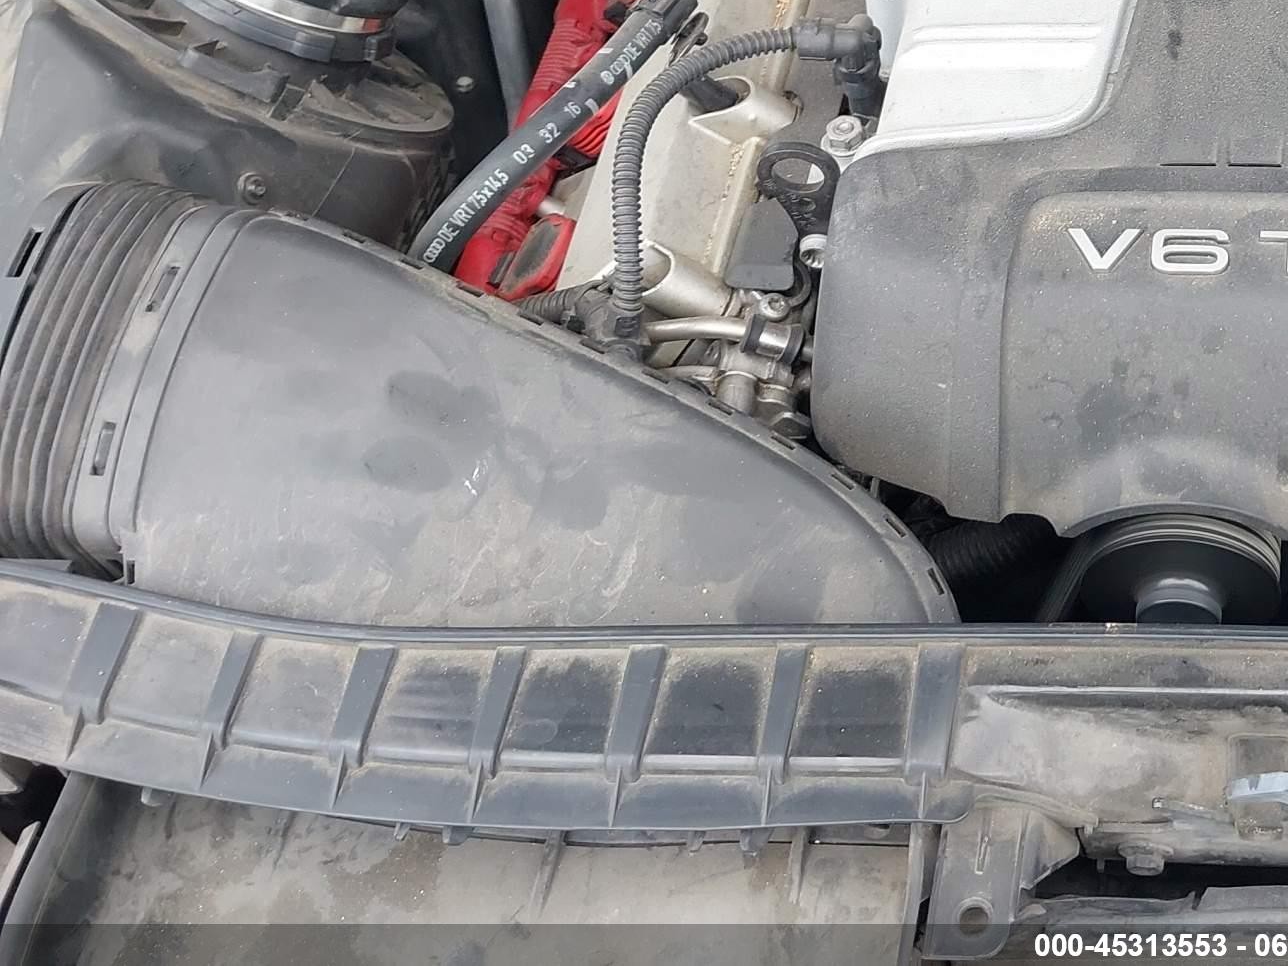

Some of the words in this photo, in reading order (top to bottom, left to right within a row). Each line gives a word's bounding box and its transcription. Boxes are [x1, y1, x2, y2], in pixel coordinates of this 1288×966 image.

[623, 42, 641, 60] DE
[633, 28, 652, 48] VRT
[439, 222, 459, 241] DE
[449, 202, 474, 226] VRT
[513, 144, 534, 163] 03
[538, 123, 560, 143] 32
[564, 102, 580, 117] 16
[1069, 227, 1230, 277] V6
